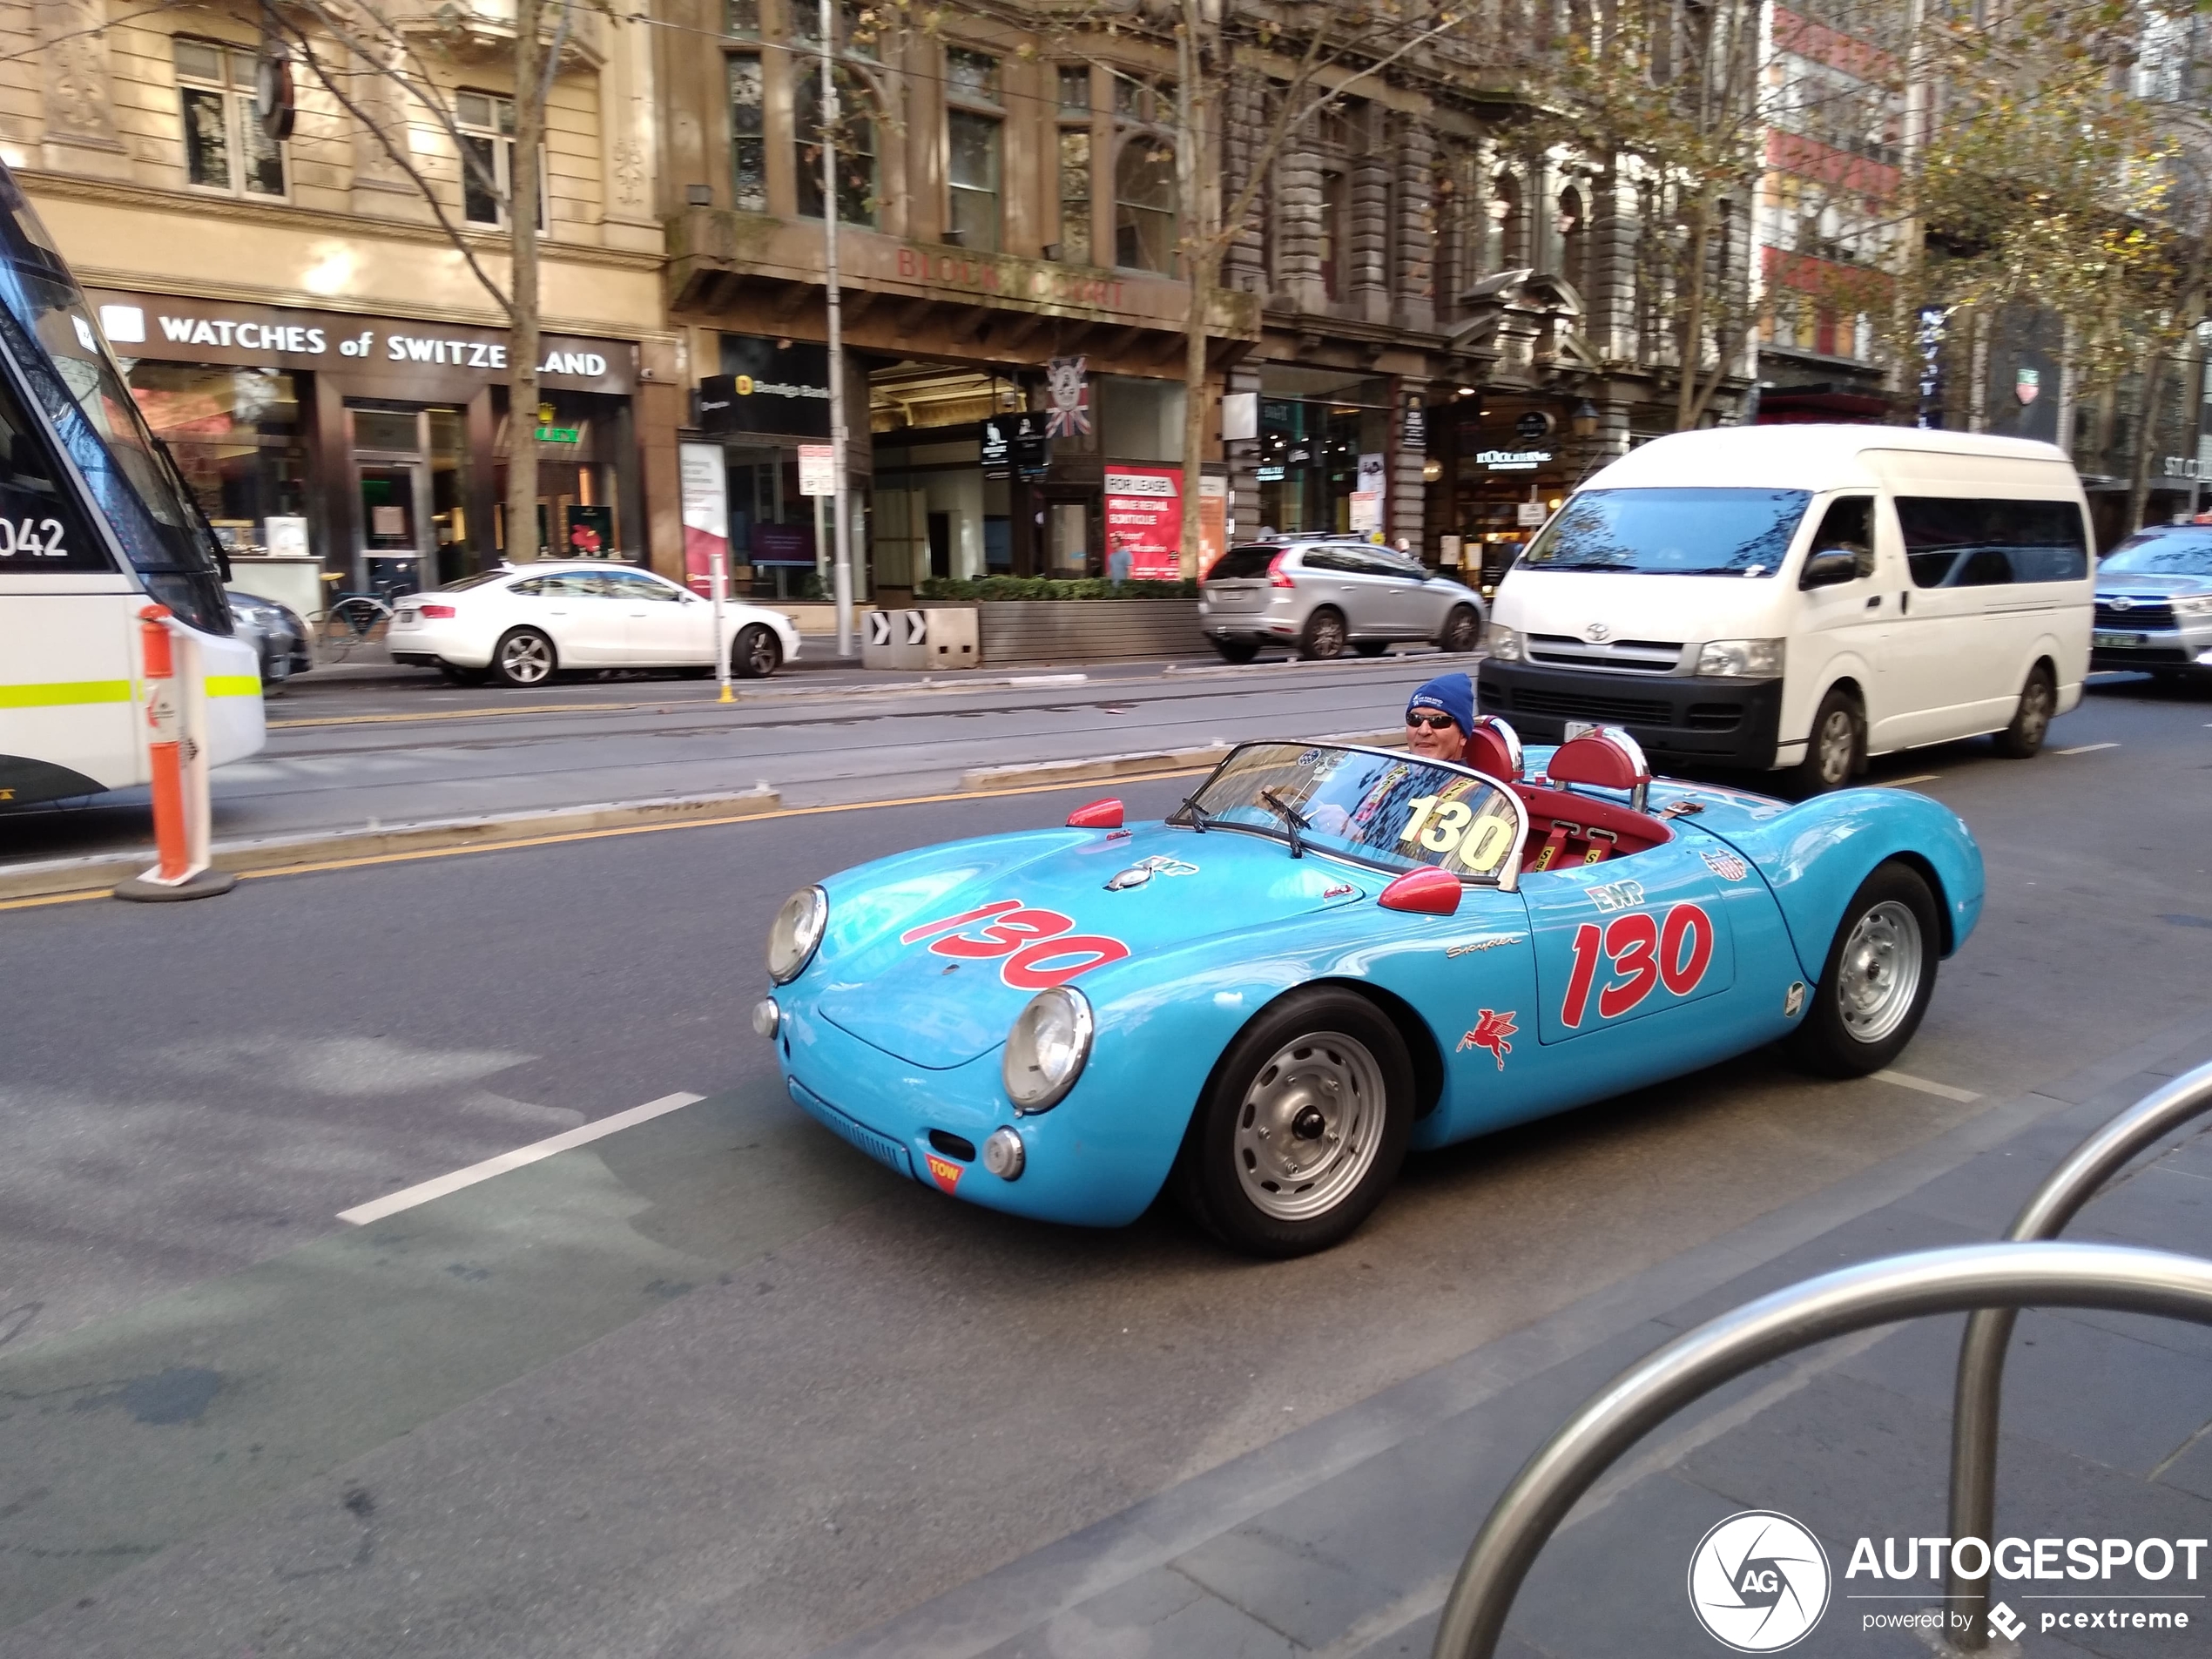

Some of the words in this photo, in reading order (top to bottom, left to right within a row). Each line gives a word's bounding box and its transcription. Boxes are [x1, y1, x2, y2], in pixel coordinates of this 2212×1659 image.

[898, 249, 998, 288] BLOCK
[1032, 271, 1123, 306] COURT
[158, 316, 327, 354] WATCHES
[339, 332, 374, 357] of
[388, 335, 607, 376] SWITZEAND
[1109, 478, 1131, 490] FOR
[1135, 480, 1169, 492] LEASE
[1399, 794, 1512, 871] 130
[1535, 849, 1551, 873] Sa
[1583, 880, 1645, 914] EWP
[900, 899, 1131, 991] 130
[1447, 937, 1522, 958] Spyder
[1561, 903, 1714, 1028] 130
[929, 1159, 959, 1181] TOW
